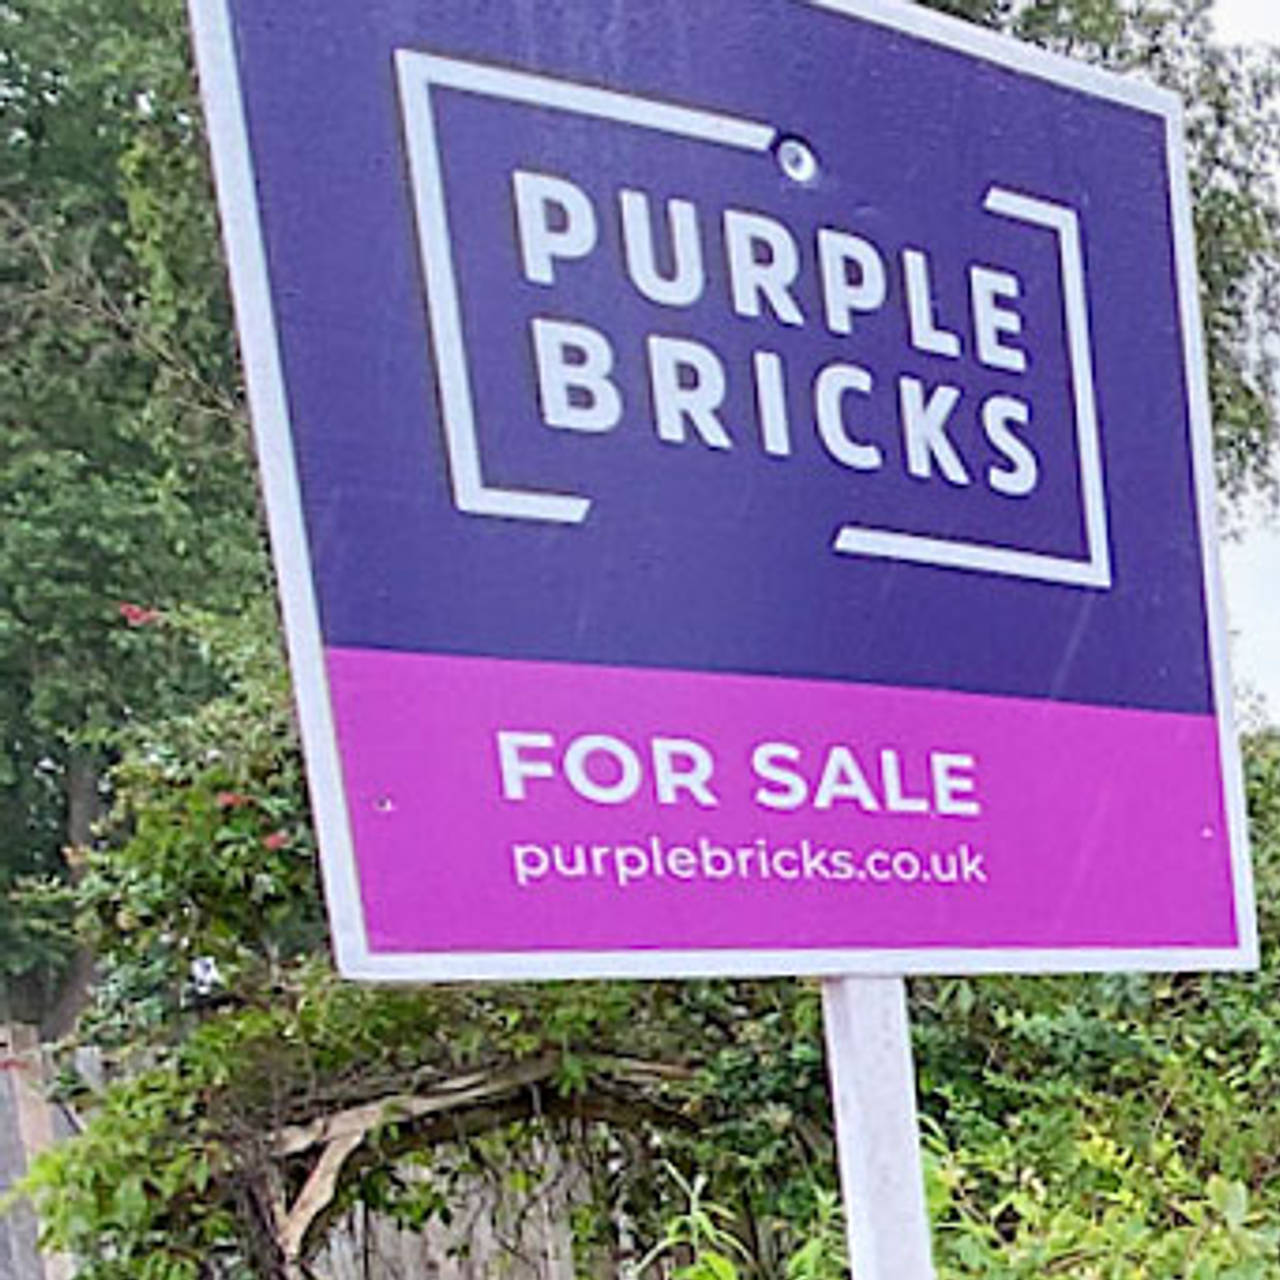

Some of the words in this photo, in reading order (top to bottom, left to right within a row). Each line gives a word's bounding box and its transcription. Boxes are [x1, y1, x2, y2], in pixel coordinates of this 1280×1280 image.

[512, 169, 1028, 373] PURPLE
[531, 317, 1039, 496] BRICKS
[496, 731, 718, 806] FOR
[750, 741, 981, 816] SALE
[513, 837, 986, 886] purplebricks.co.uk
